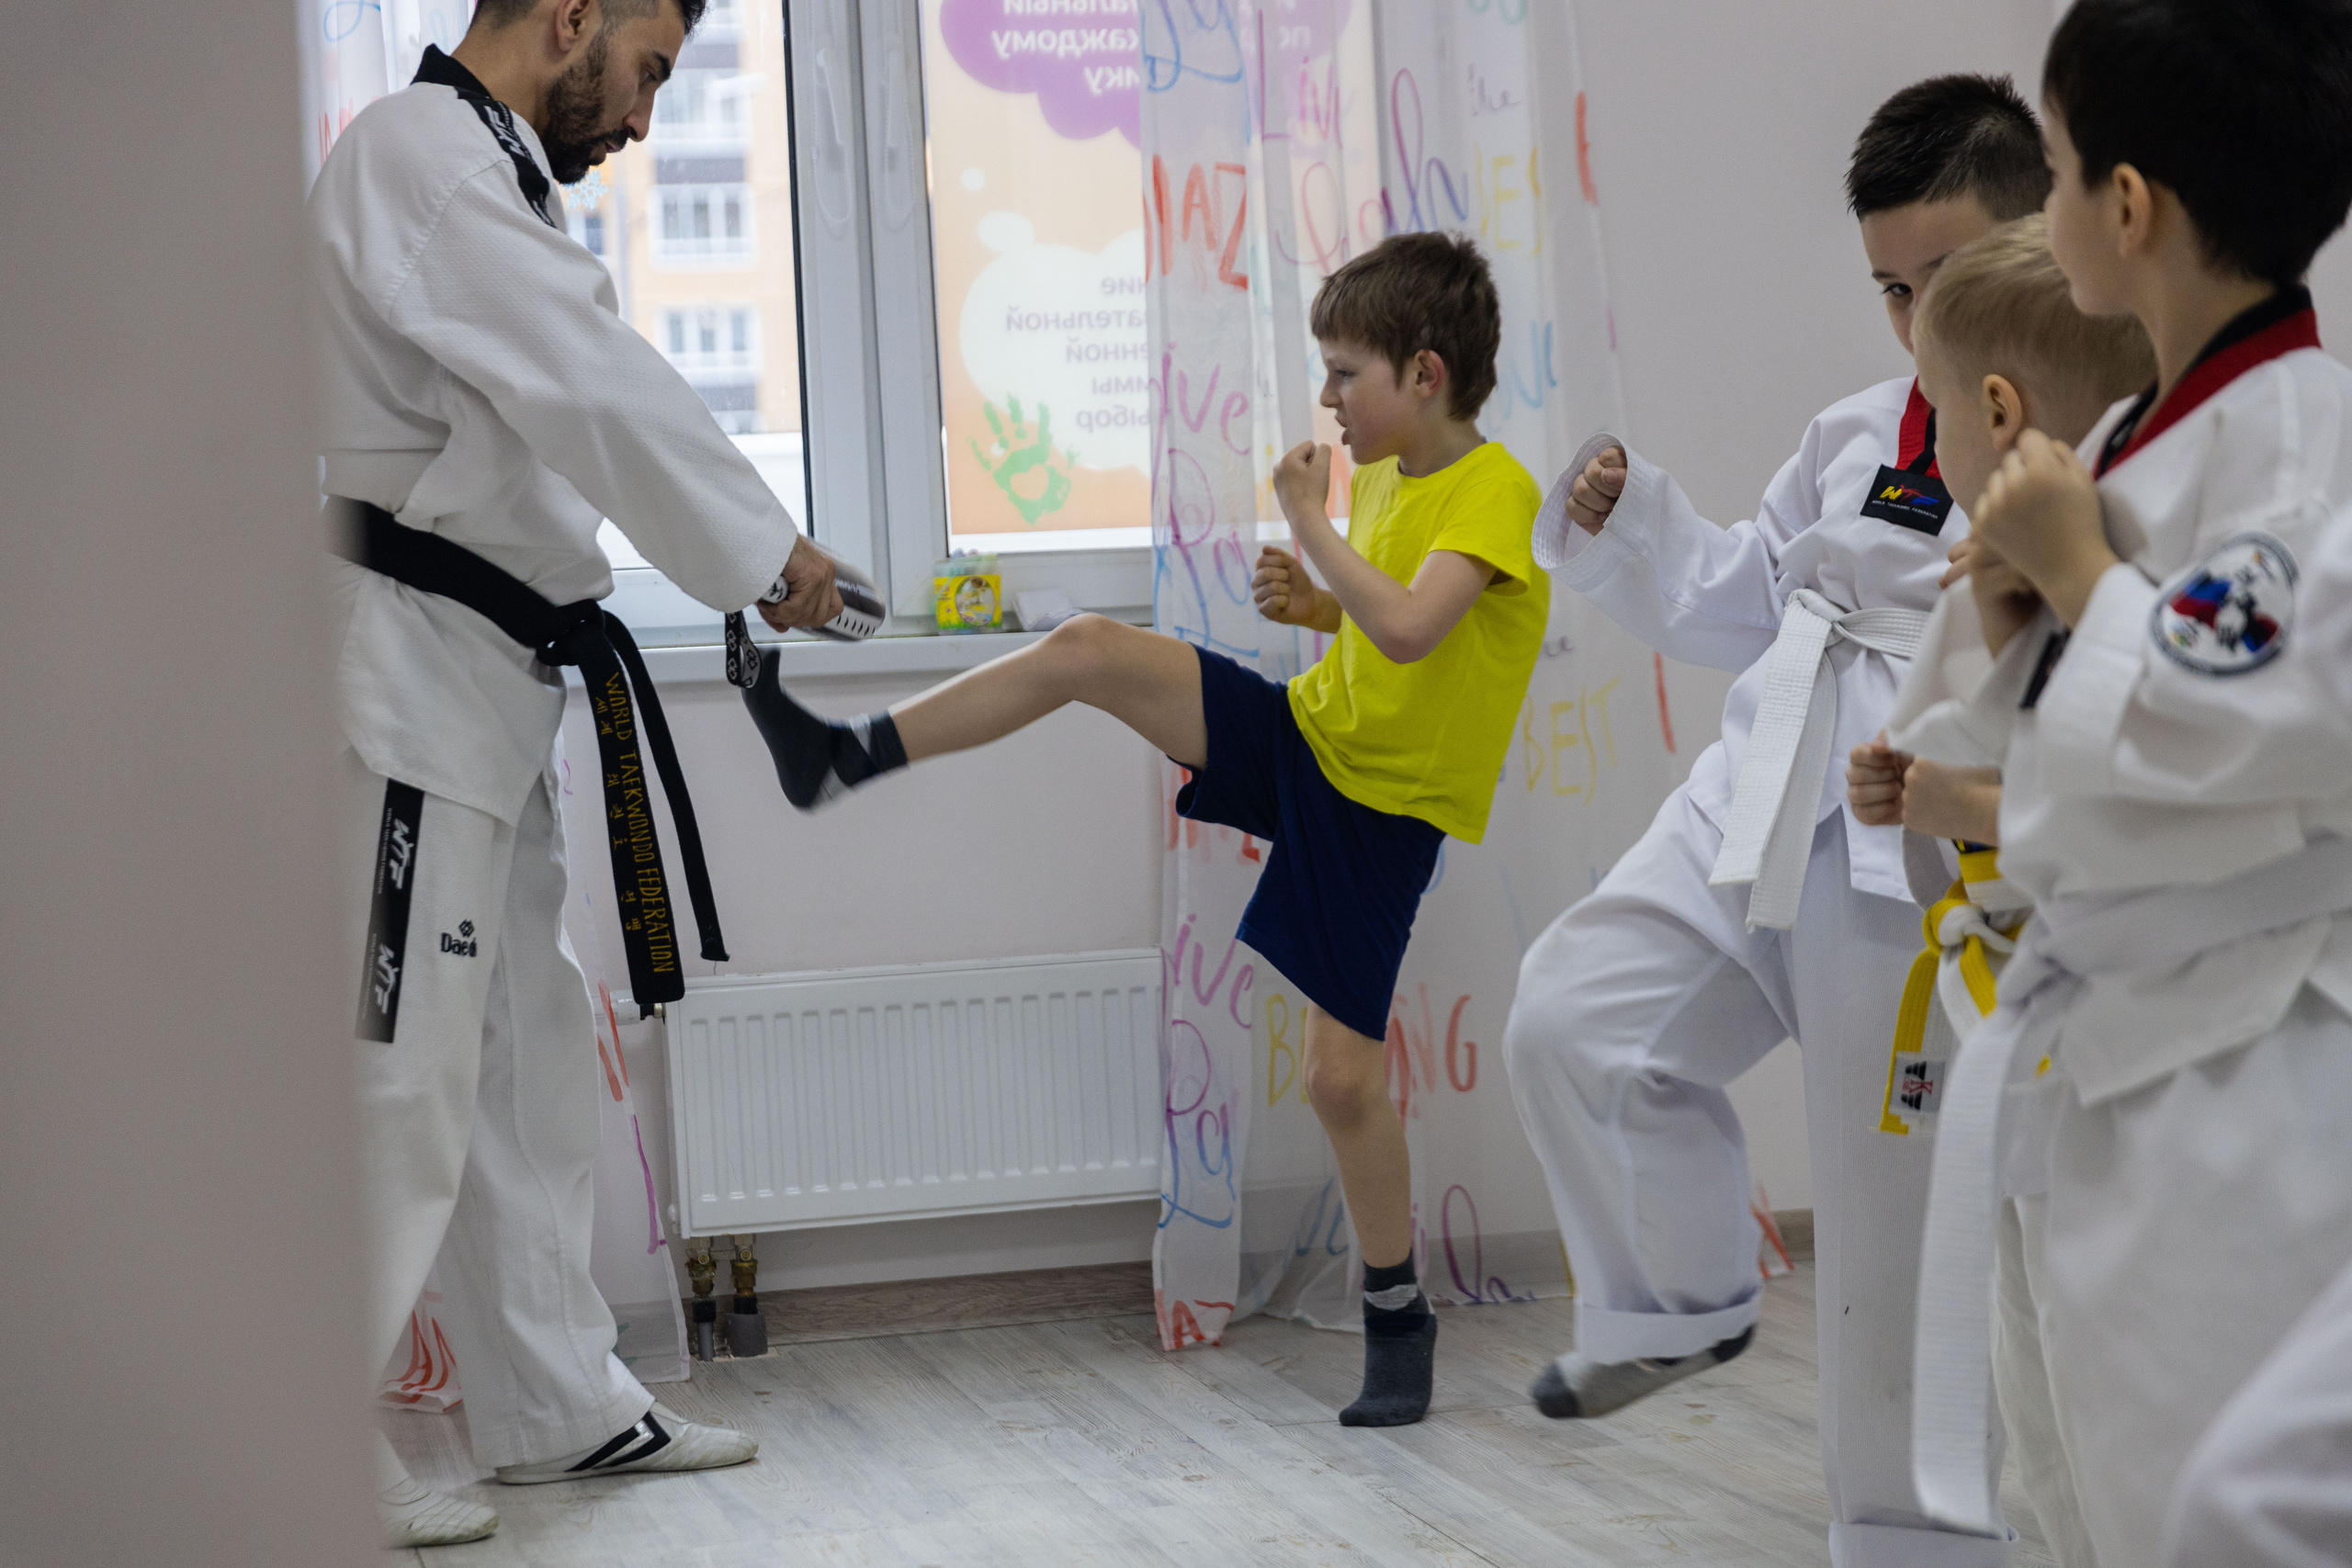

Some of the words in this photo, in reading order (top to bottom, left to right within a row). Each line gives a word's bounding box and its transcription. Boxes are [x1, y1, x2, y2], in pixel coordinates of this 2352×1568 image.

[605, 671, 633, 740] WORLD
[620, 750, 654, 863] TAEKWONDO
[637, 867, 674, 974] FEDERATION
